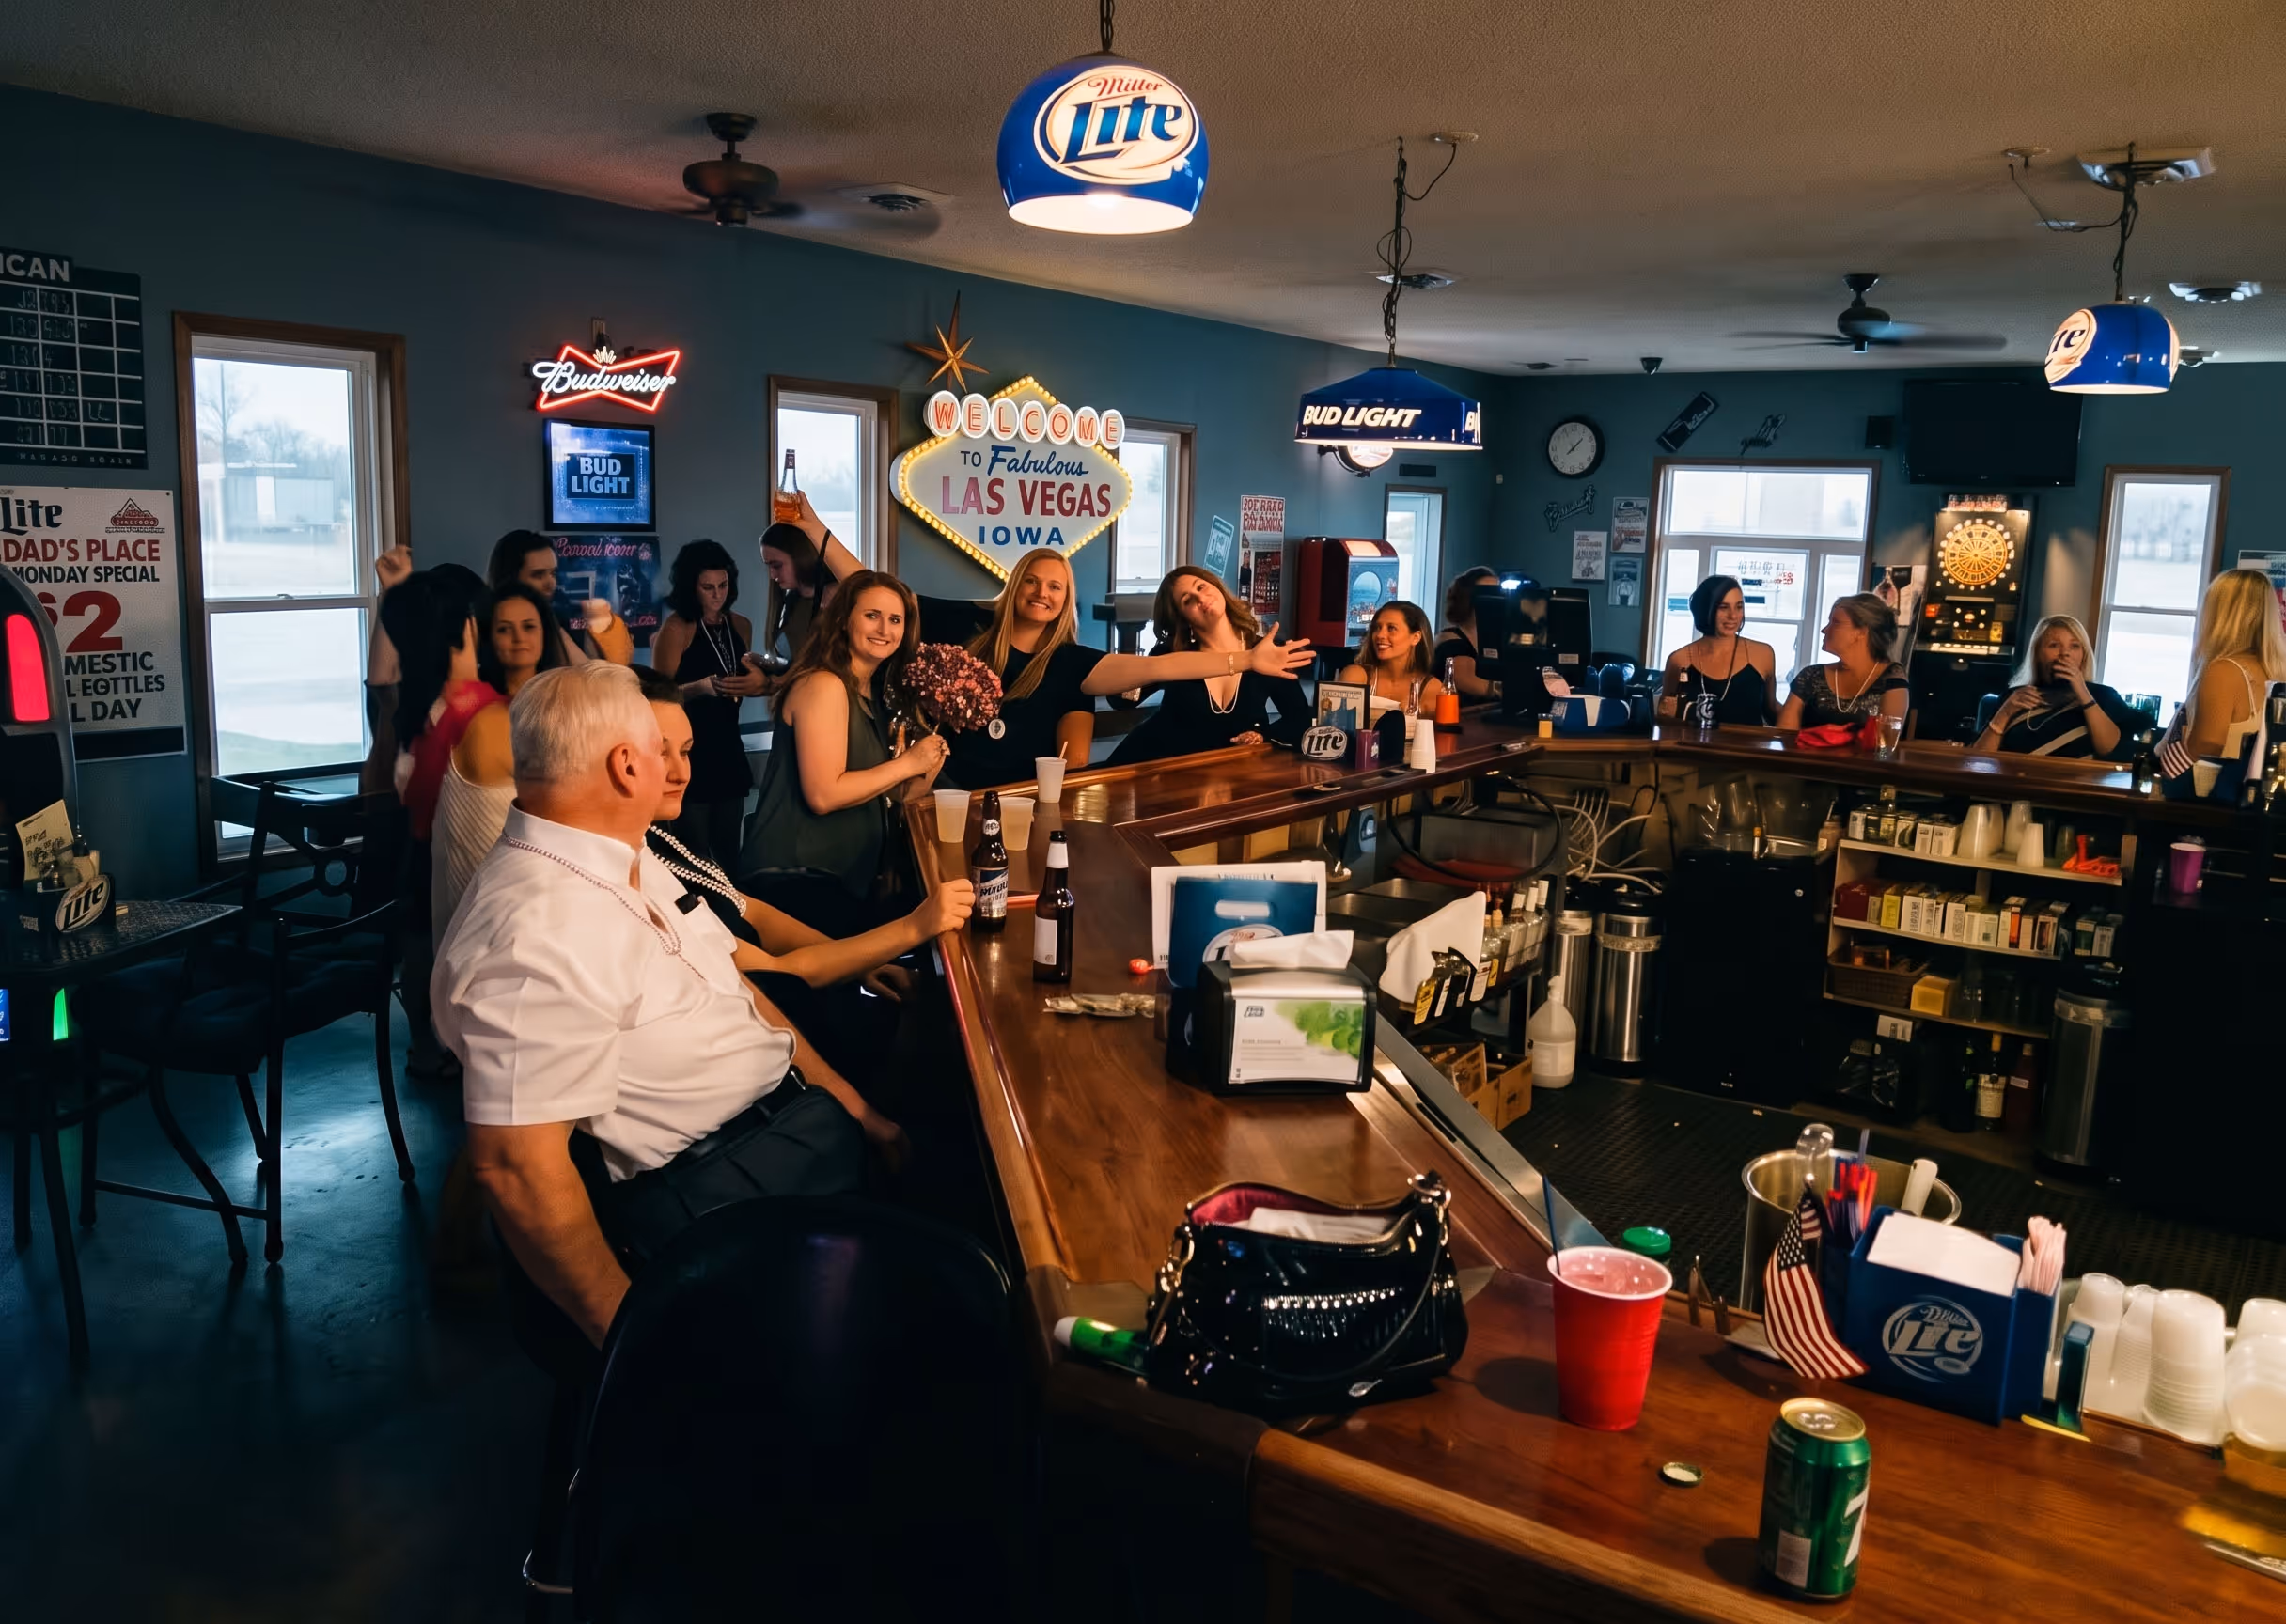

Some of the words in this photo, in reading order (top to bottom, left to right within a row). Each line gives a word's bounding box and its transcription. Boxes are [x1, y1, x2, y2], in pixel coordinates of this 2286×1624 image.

[1087, 76, 1164, 97] Miller
[1061, 95, 1182, 164] Lite
[532, 361, 677, 394] Budweiser
[934, 400, 1119, 442] WELCOME
[1302, 405, 1343, 426] BUD
[1341, 406, 1422, 428] LIGHT
[579, 456, 622, 476] BUD
[960, 450, 982, 468] TO
[987, 445, 1089, 476] Fabulous
[571, 475, 631, 494] LIGHT
[942, 476, 1005, 515] LAS
[1018, 479, 1112, 518] VEGAS
[0, 497, 63, 536] Lite
[979, 525, 1066, 546] IOWA
[3, 539, 80, 563] DAD'S
[86, 539, 161, 562] PLACE
[93, 565, 160, 583] SPECIAL
[91, 697, 142, 721] DAY
